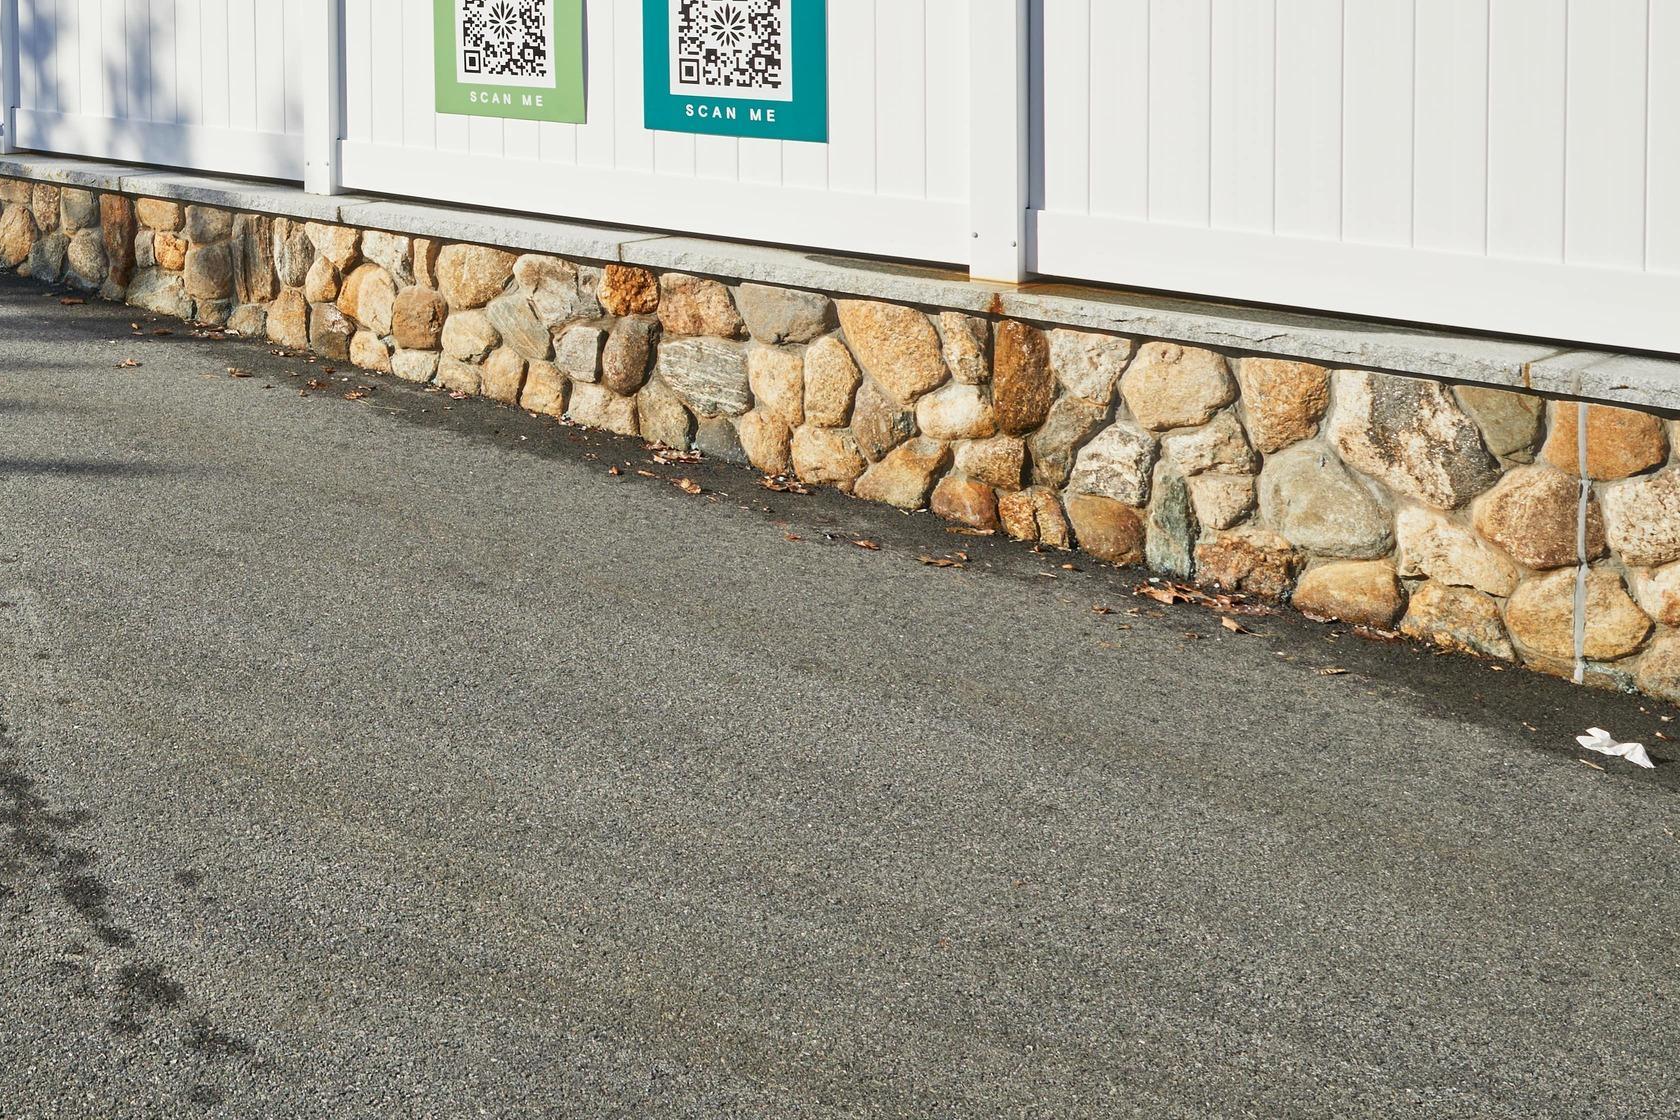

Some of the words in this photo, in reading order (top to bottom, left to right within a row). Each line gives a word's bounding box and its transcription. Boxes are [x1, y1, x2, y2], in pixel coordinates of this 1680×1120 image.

[469, 91, 512, 105] SCAN
[521, 94, 544, 107] ME
[685, 104, 737, 120] SCAN
[749, 108, 776, 122] ME
